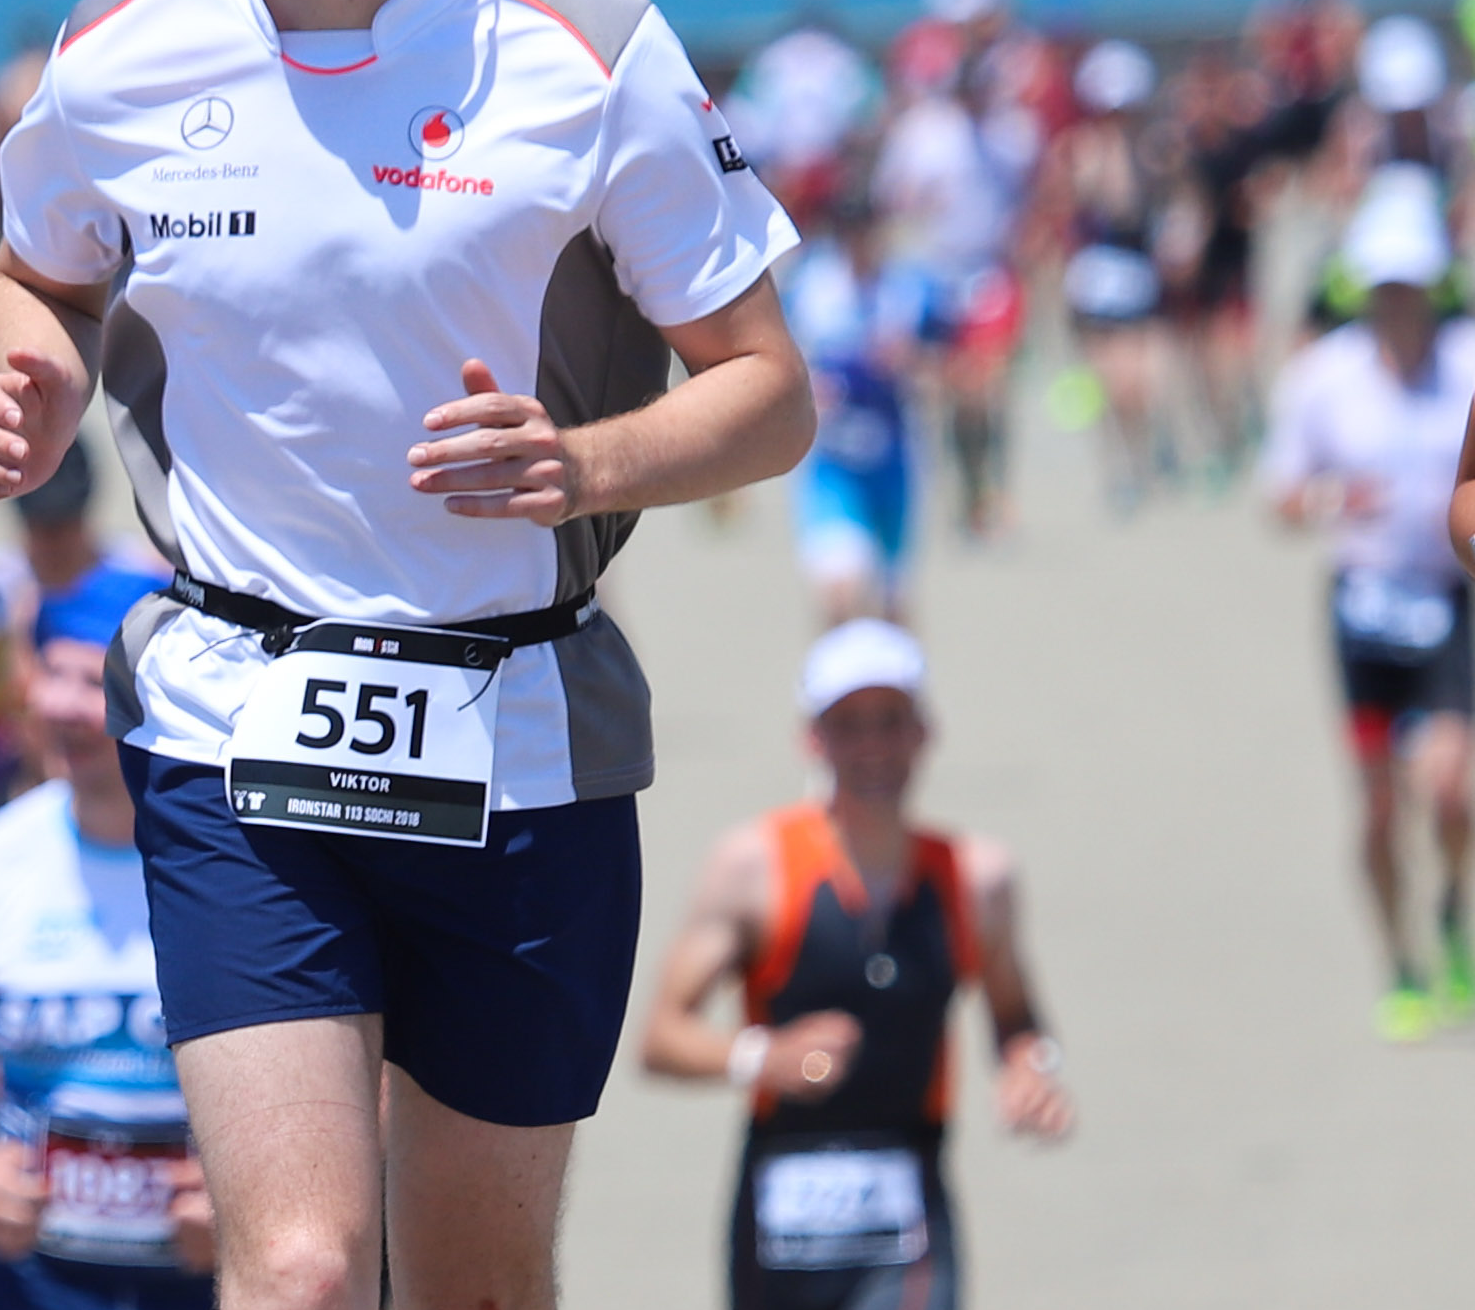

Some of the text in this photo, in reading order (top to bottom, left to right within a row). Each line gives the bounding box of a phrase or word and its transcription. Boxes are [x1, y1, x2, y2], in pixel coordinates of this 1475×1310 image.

[153, 163, 260, 182] Mercedes-Benz
[373, 164, 494, 196] vodafone
[150, 211, 222, 239] Mobil
[295, 677, 430, 760] 551
[329, 771, 392, 793] VIKTOR
[287, 797, 421, 827] IRONSTAR 113 SOCHI 2018
